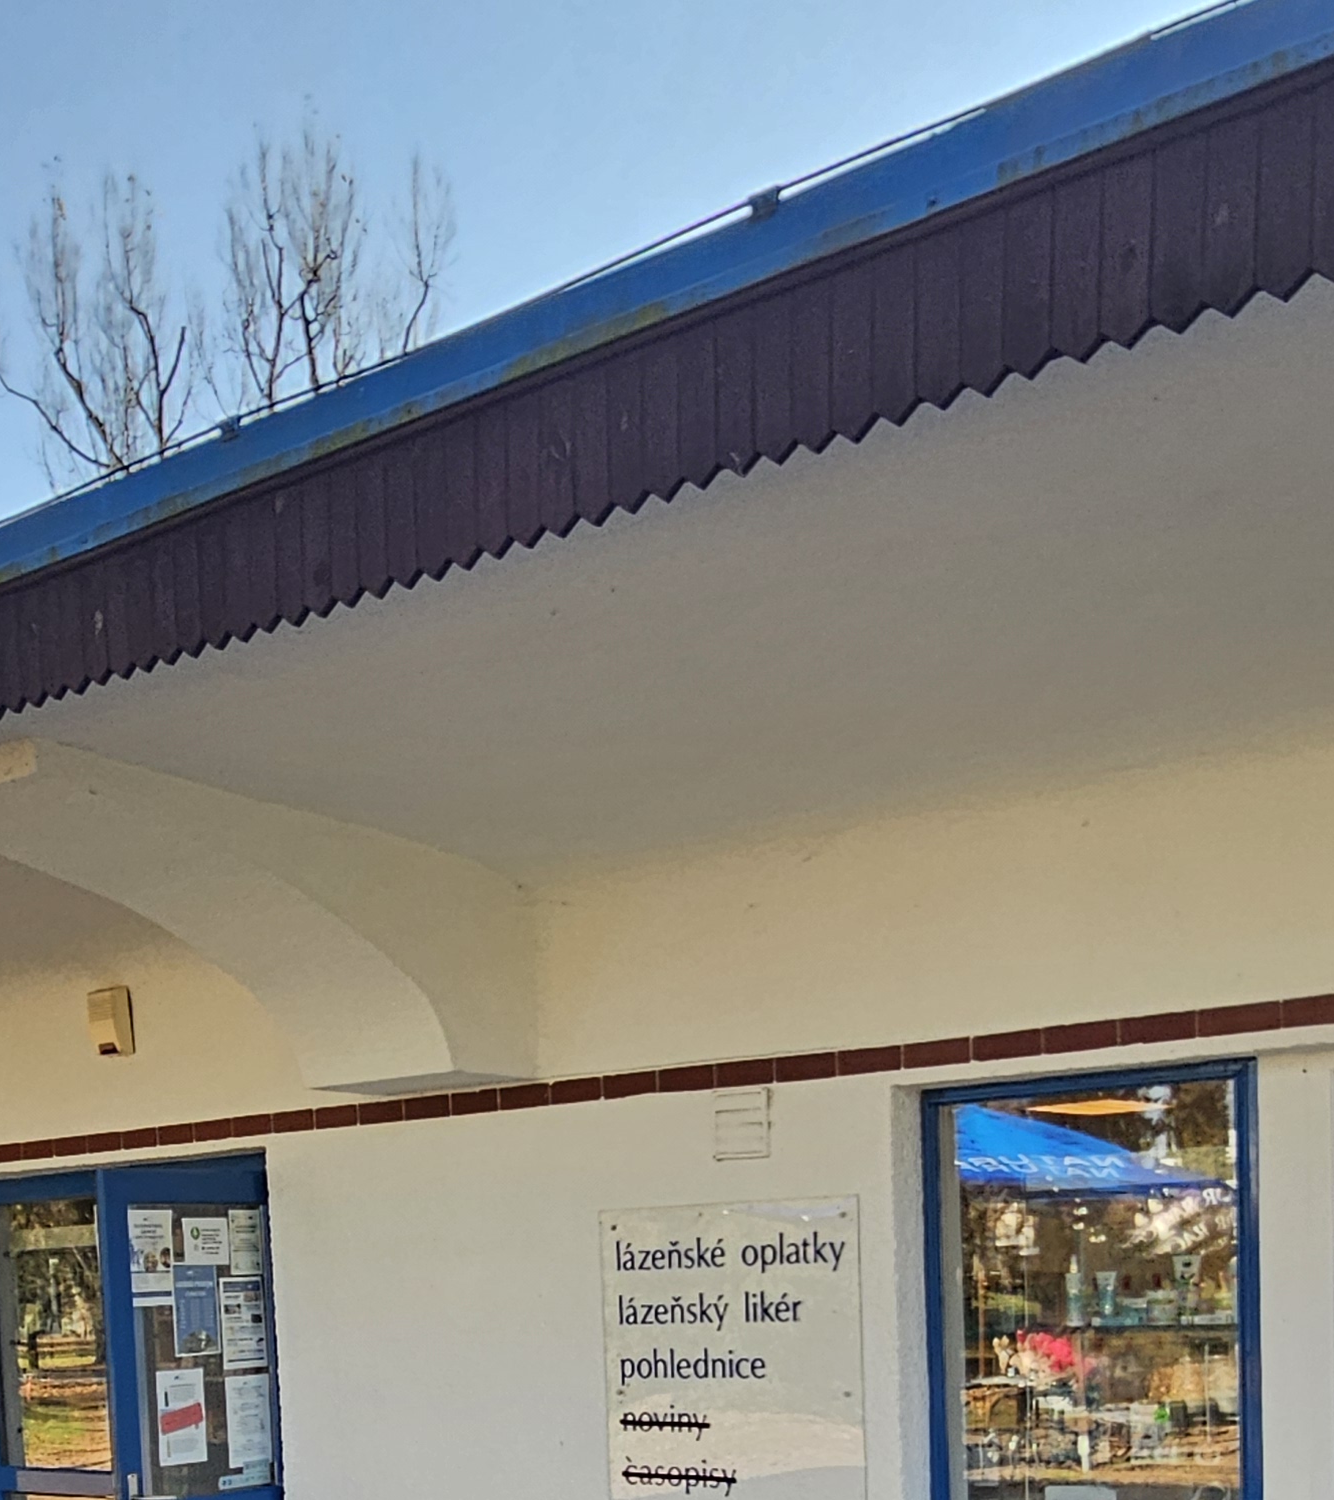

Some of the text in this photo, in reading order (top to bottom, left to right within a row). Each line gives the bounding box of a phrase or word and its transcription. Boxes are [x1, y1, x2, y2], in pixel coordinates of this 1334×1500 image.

[615, 1231, 846, 1273] lázeňské oplatky
[618, 1291, 803, 1331] lázeňský likér
[620, 1348, 767, 1386] pohlednice
[620, 1405, 710, 1441] noviny
[622, 1456, 737, 1497] časopisy
